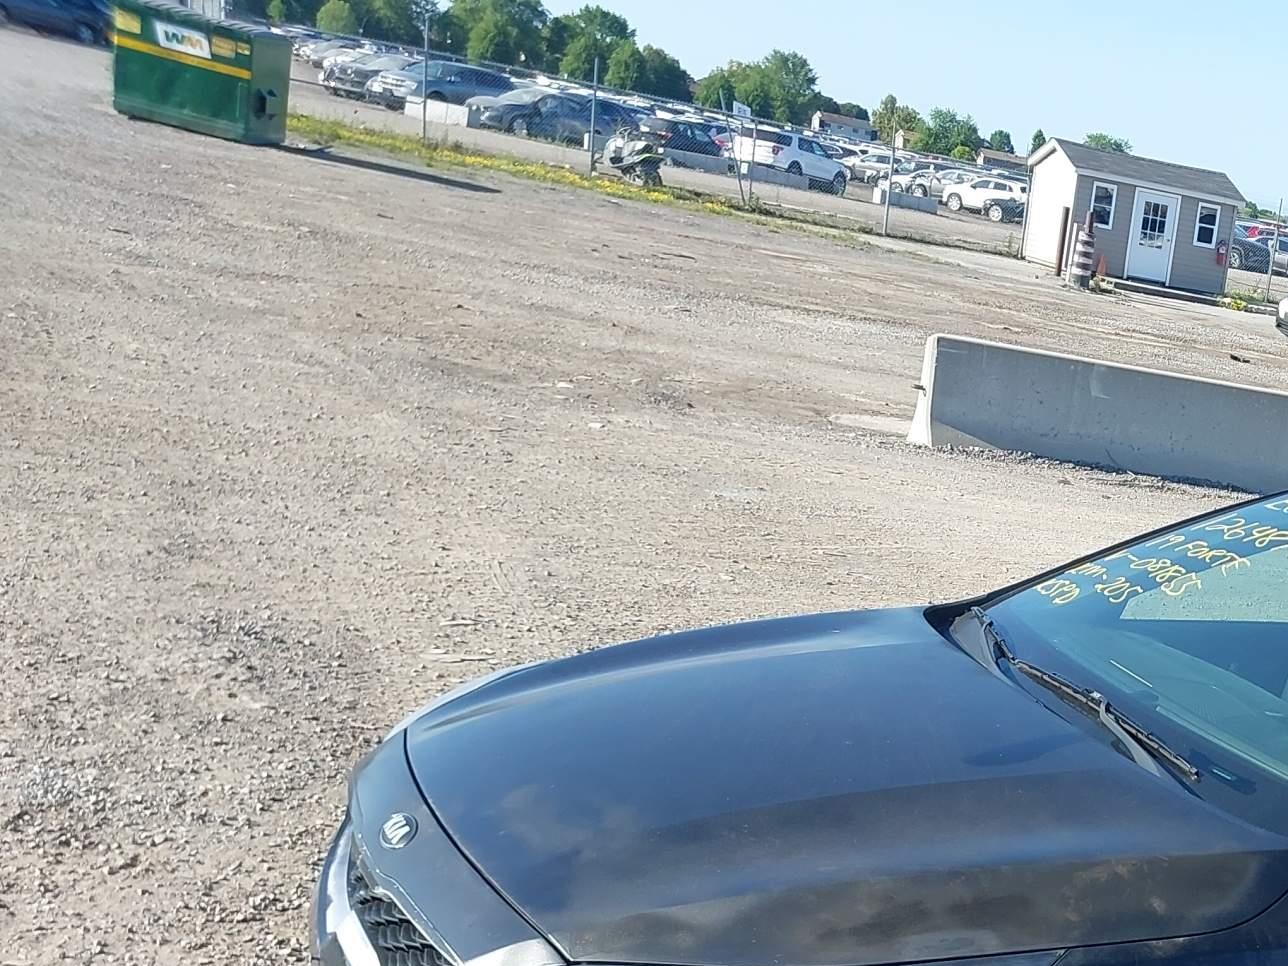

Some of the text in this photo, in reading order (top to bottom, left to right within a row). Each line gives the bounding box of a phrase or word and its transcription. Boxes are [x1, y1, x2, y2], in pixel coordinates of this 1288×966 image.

[164, 30, 205, 51] WM
[1145, 534, 1251, 577] 19 FORTE
